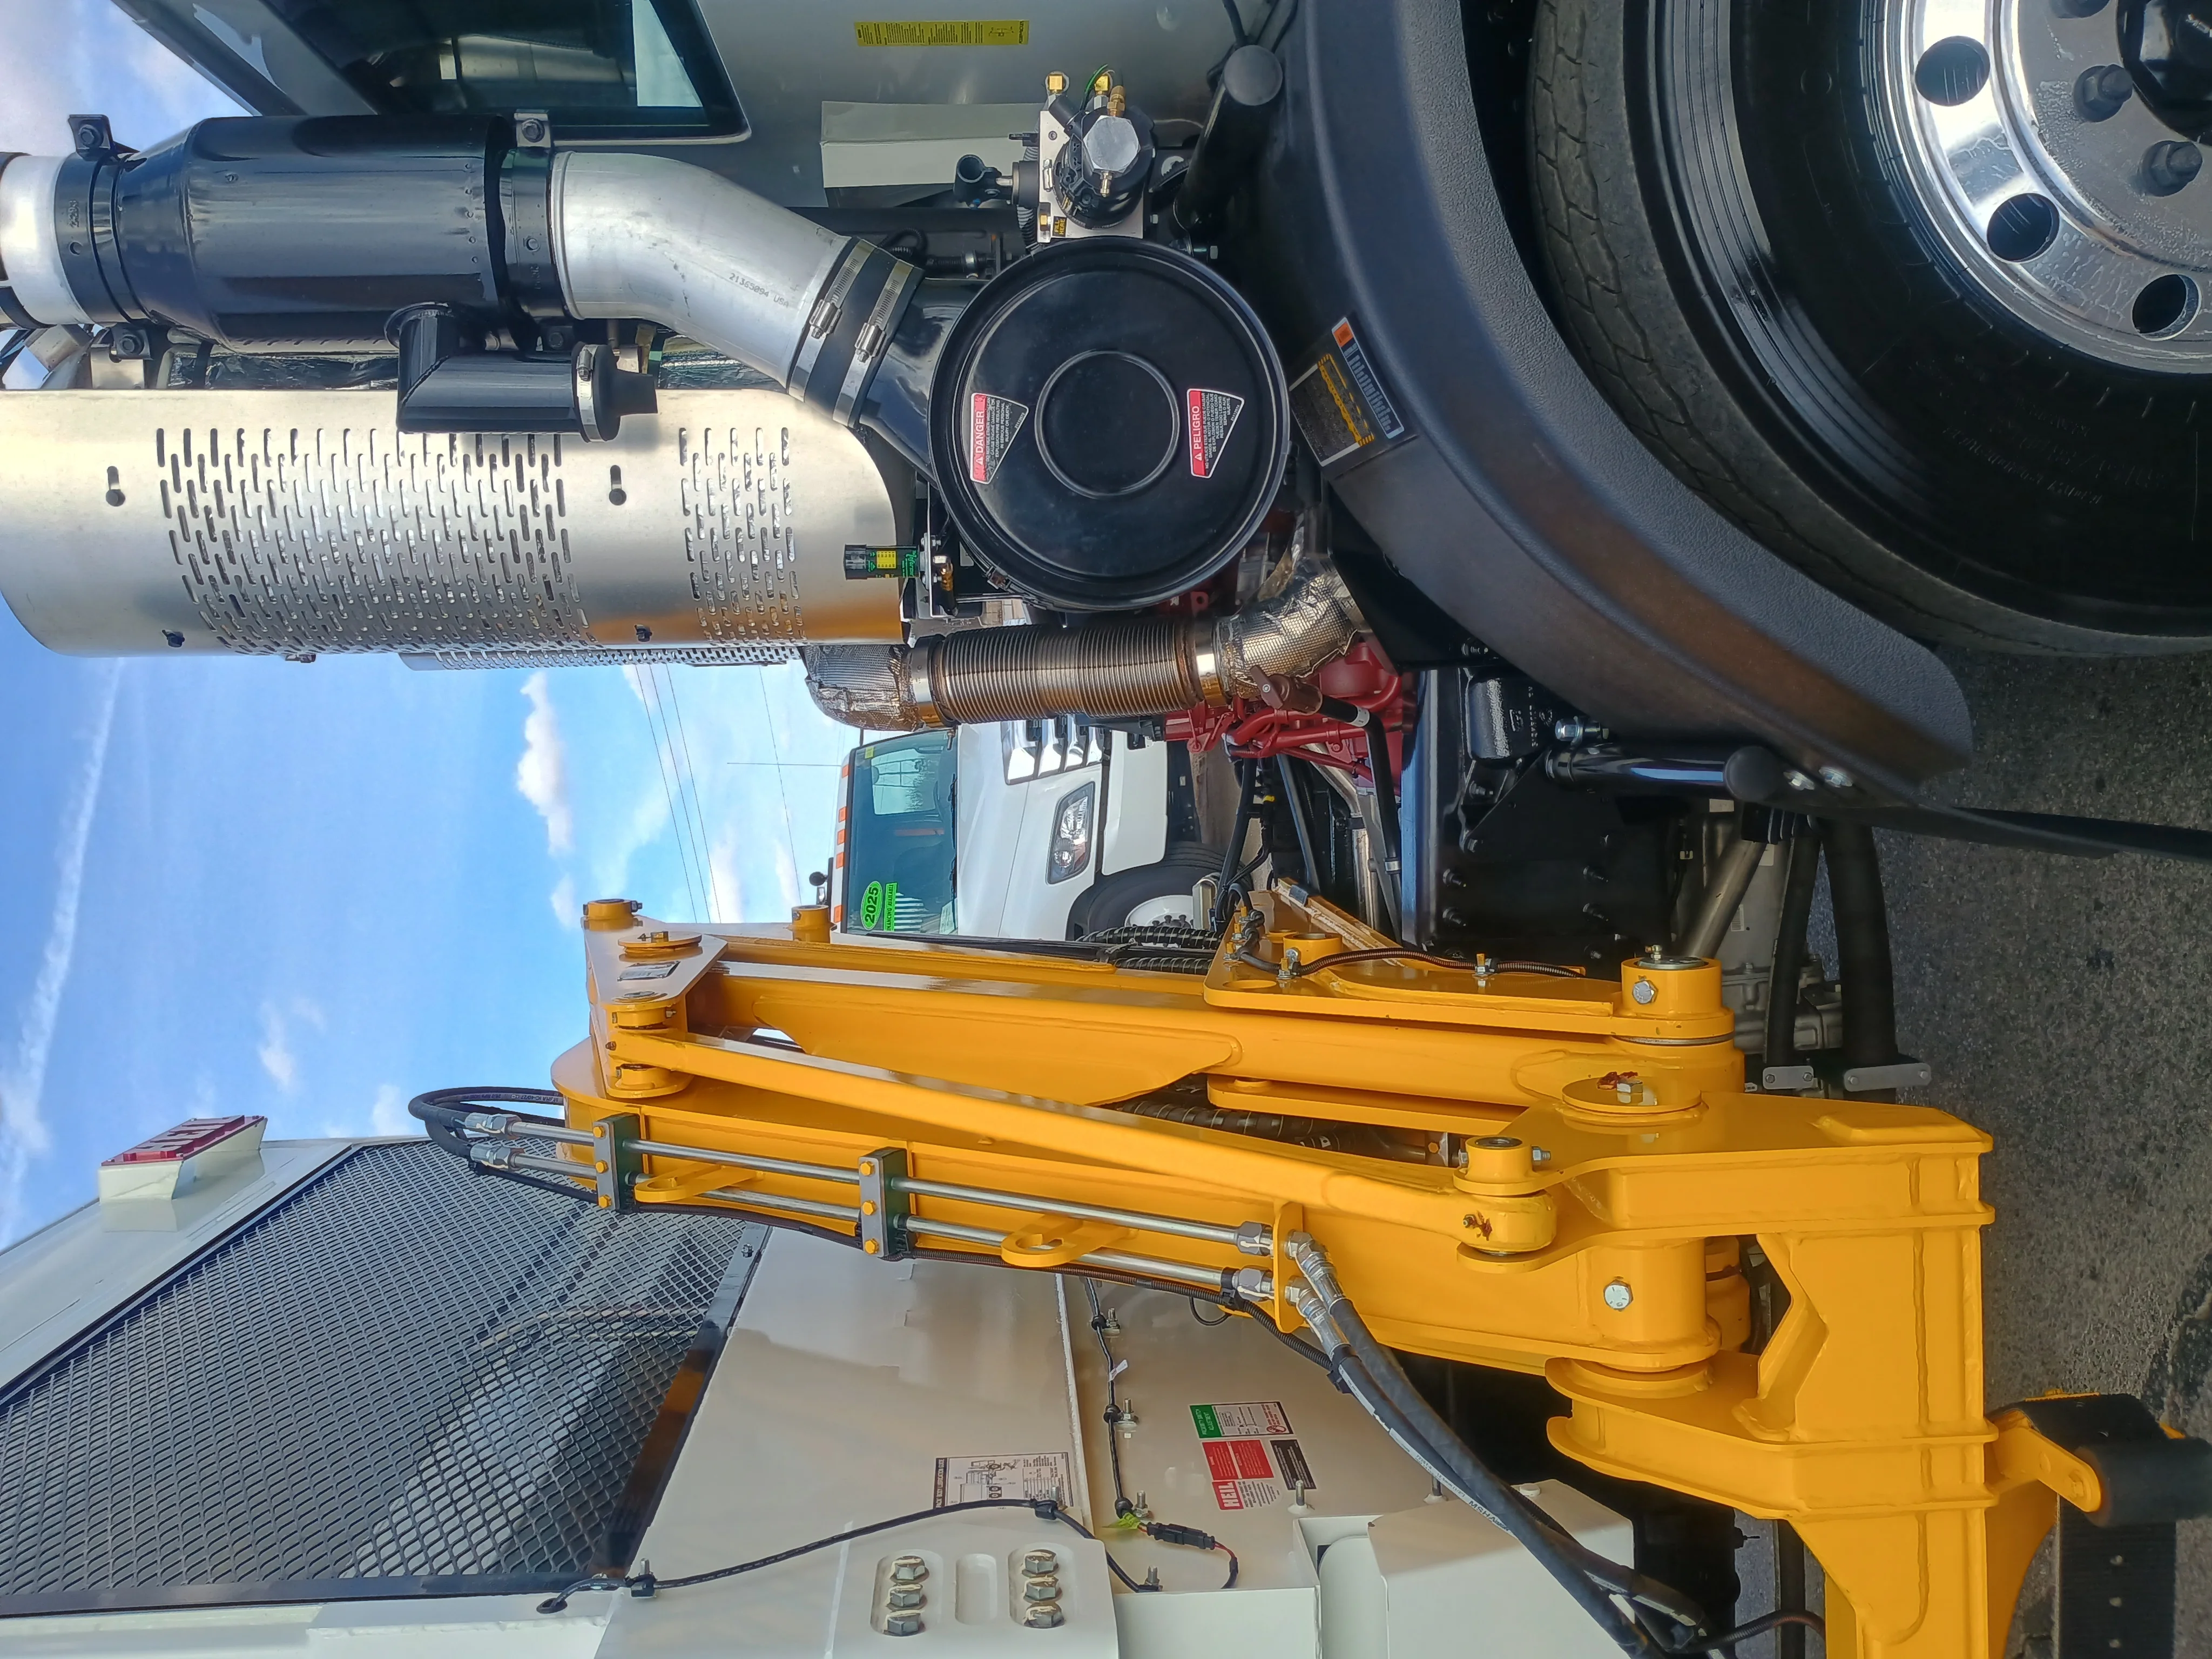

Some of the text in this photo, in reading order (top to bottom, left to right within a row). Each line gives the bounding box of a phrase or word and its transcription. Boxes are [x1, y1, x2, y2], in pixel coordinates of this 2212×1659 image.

[773, 295, 788, 308] USA
[975, 411, 984, 453] DANGER
[1192, 406, 1202, 449] PELIGRO
[865, 886, 879, 923] 2025
[123, 1115, 244, 1162] HEIL
[1218, 1482, 1240, 1507] HEIL
[1468, 1499, 1496, 1523] MSHA
